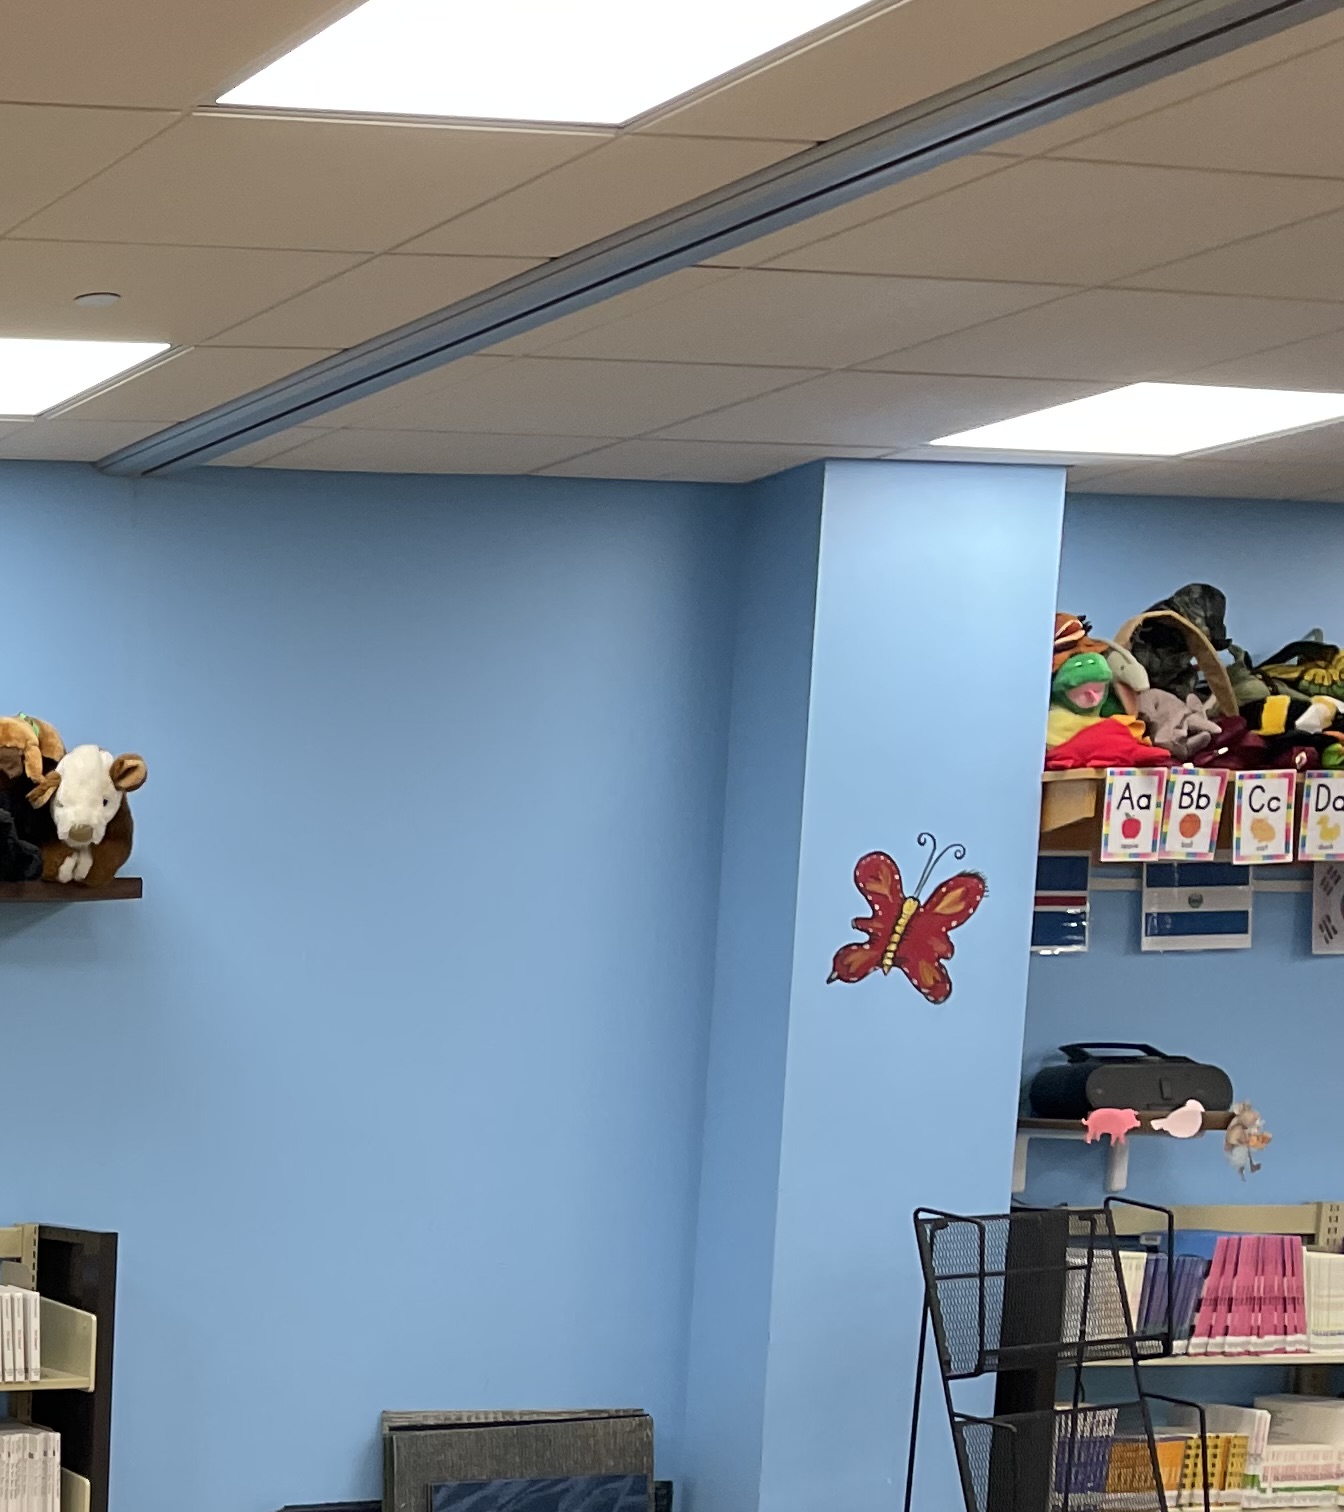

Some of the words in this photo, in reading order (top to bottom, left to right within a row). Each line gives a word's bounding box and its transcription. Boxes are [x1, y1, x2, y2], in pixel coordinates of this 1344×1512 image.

[1117, 782, 1152, 811] Aa
[1178, 780, 1211, 810] Bb
[1249, 785, 1281, 813] Cc
